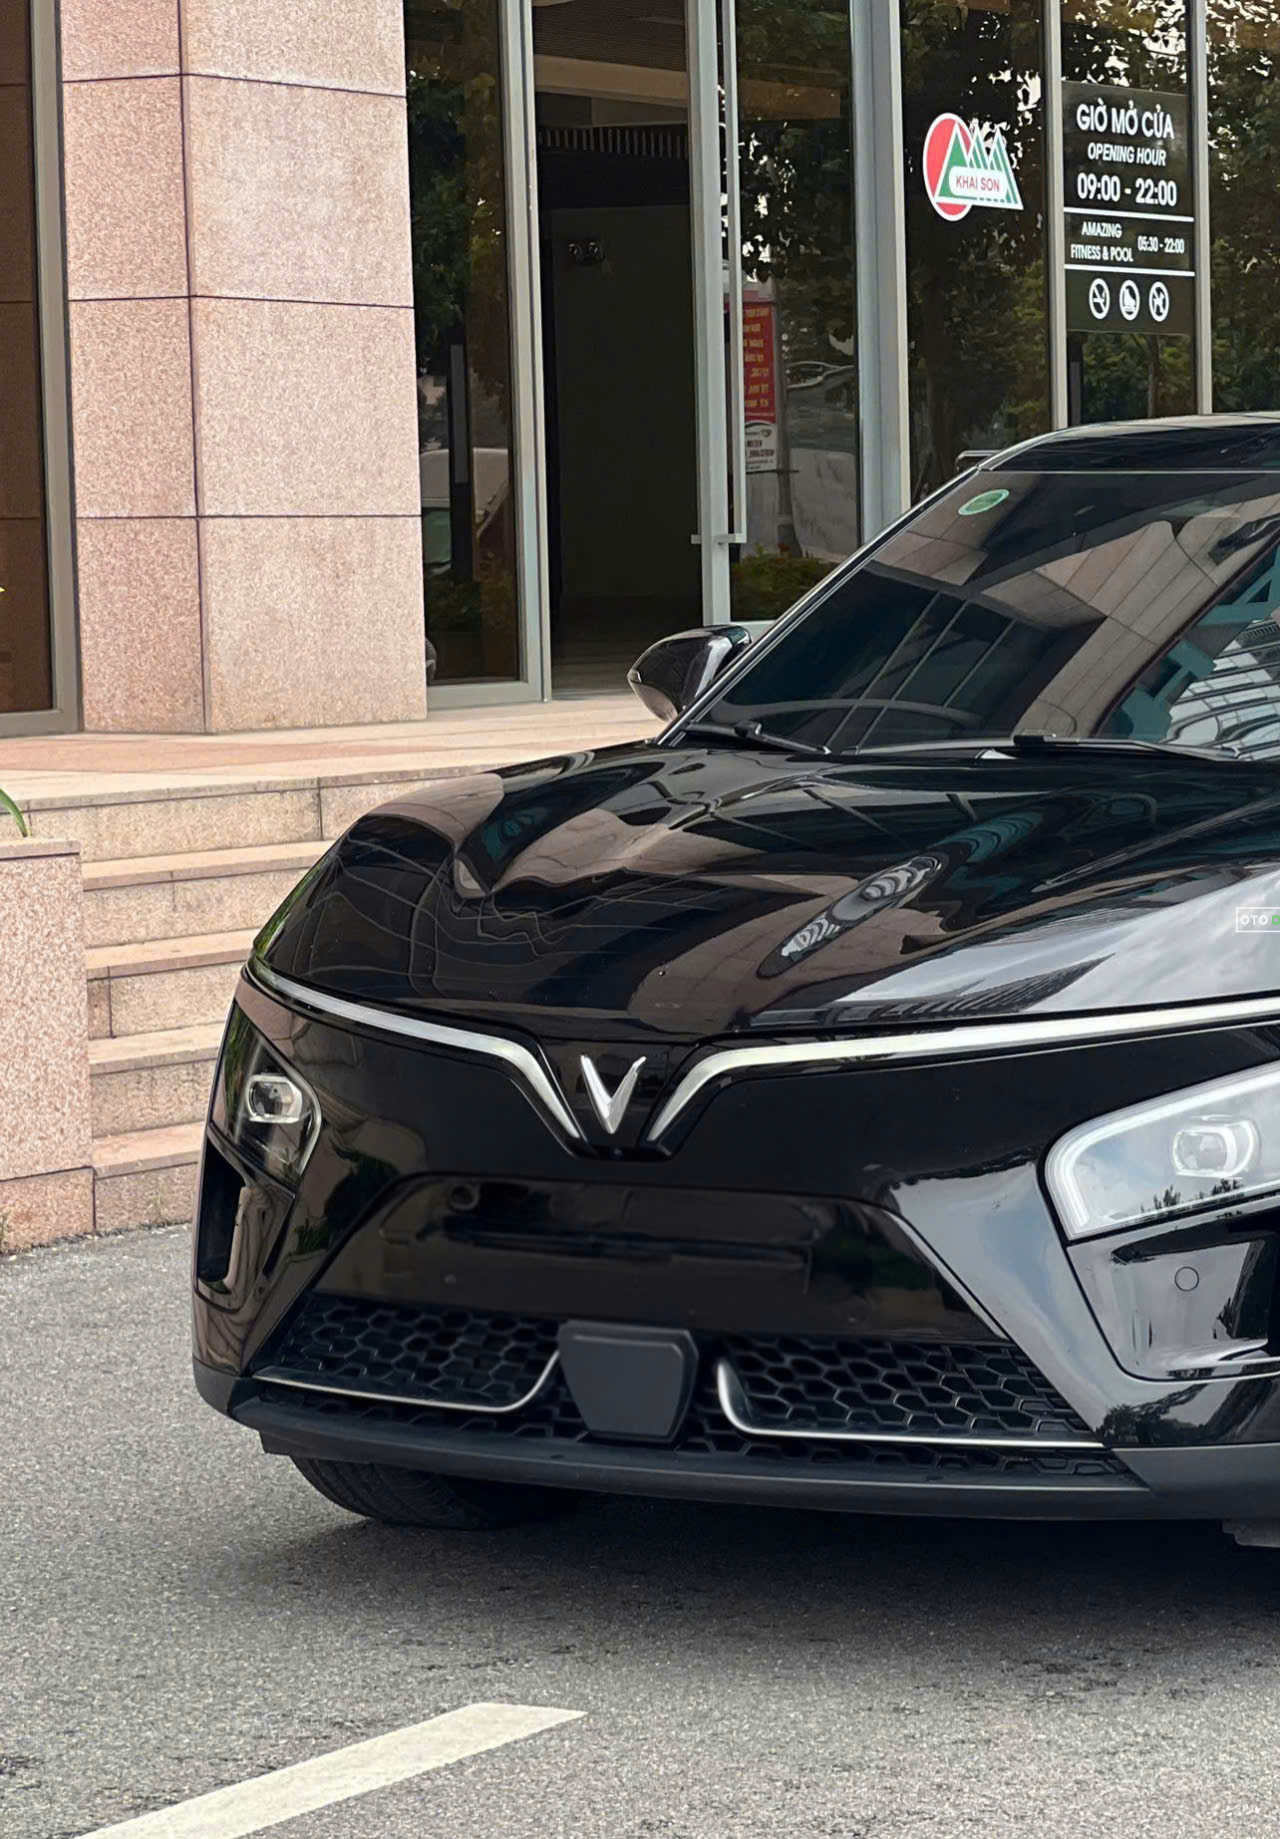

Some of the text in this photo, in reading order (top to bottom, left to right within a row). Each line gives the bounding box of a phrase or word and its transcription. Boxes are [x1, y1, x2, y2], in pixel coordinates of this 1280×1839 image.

[1076, 97, 1175, 139] GIỜ MỞ CỬA
[1087, 142, 1167, 167] OPENING HOUR
[956, 175, 1000, 192] KHAI SON
[1077, 172, 1121, 202] 09:00
[1135, 177, 1177, 207] 22:00
[1081, 221, 1123, 238] AMAZING
[1070, 243, 1134, 262] FITNESS & POOL
[1137, 235, 1159, 252] 05:30
[1164, 237, 1185, 254] 22:00
